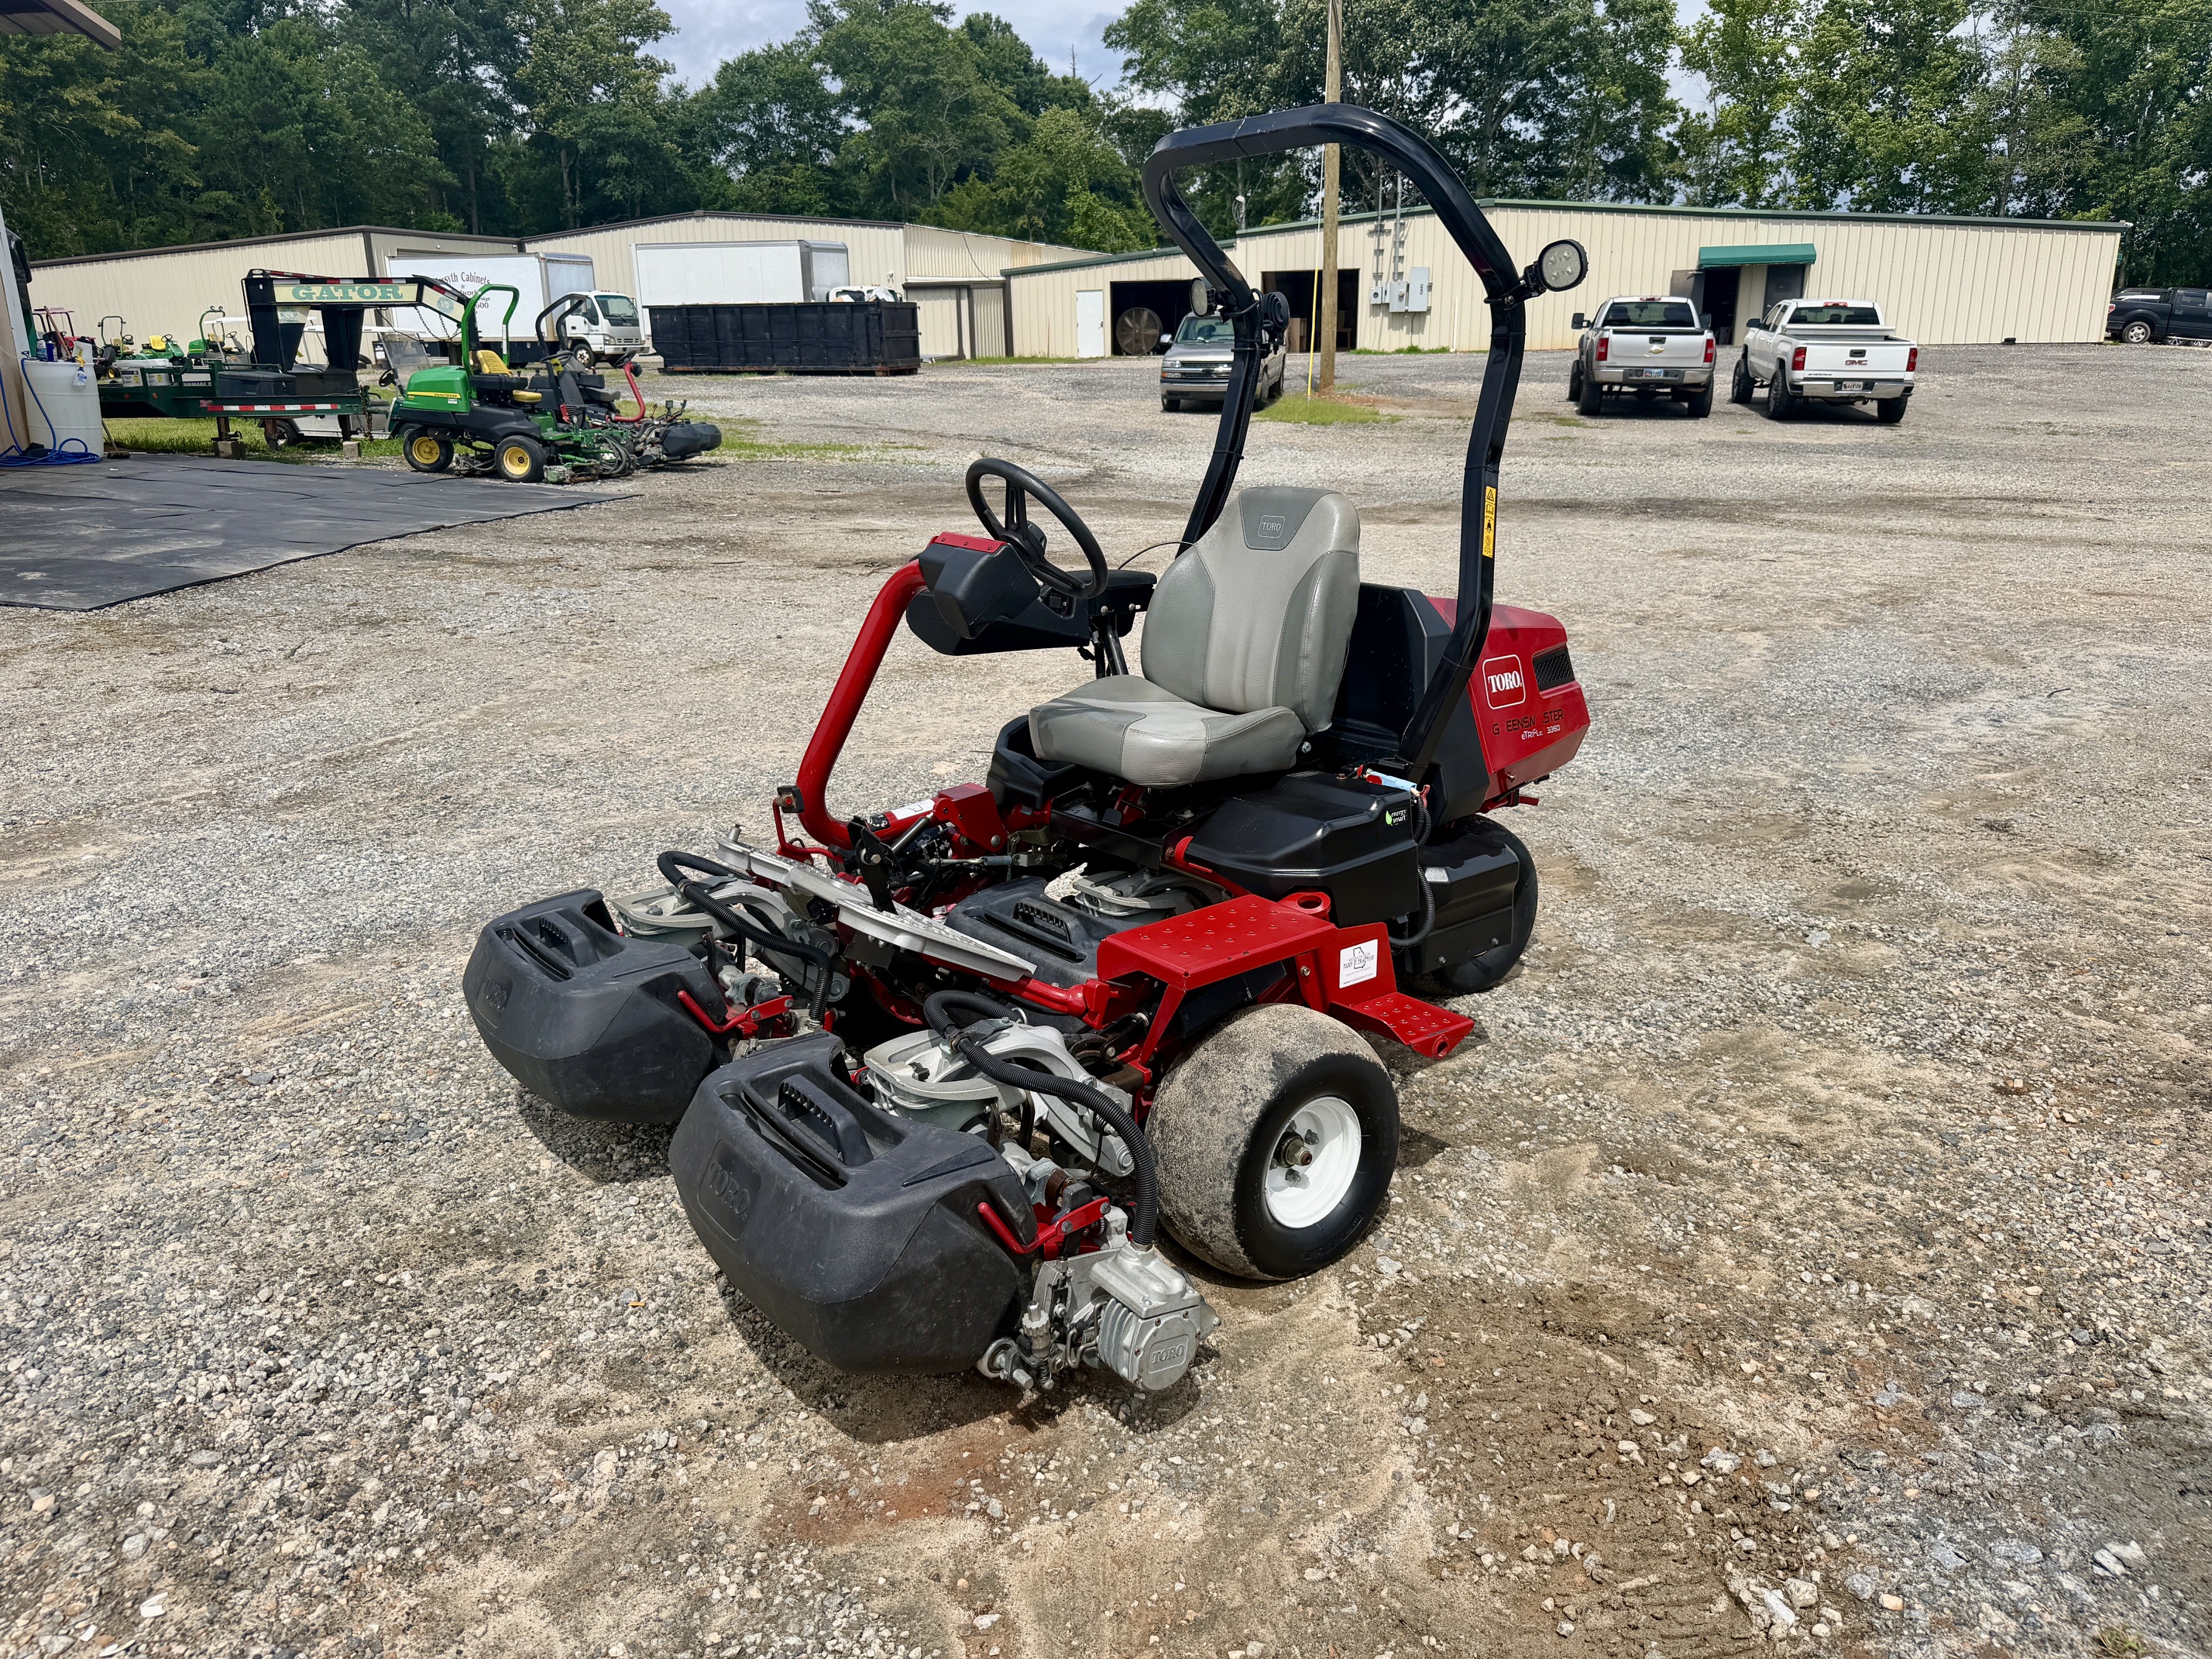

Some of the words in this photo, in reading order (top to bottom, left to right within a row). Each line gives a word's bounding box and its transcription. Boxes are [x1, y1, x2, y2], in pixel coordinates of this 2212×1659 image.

[461, 272, 490, 287] Cabinets
[292, 285, 404, 301] GATOR
[1262, 522, 1282, 531] TORO
[1488, 671, 1520, 693] TORO
[1391, 809, 1407, 817] energy
[1393, 815, 1407, 823] smart
[483, 974, 507, 1010] TORO
[710, 1159, 750, 1216] TORO
[1152, 1344, 1185, 1364] TORO
